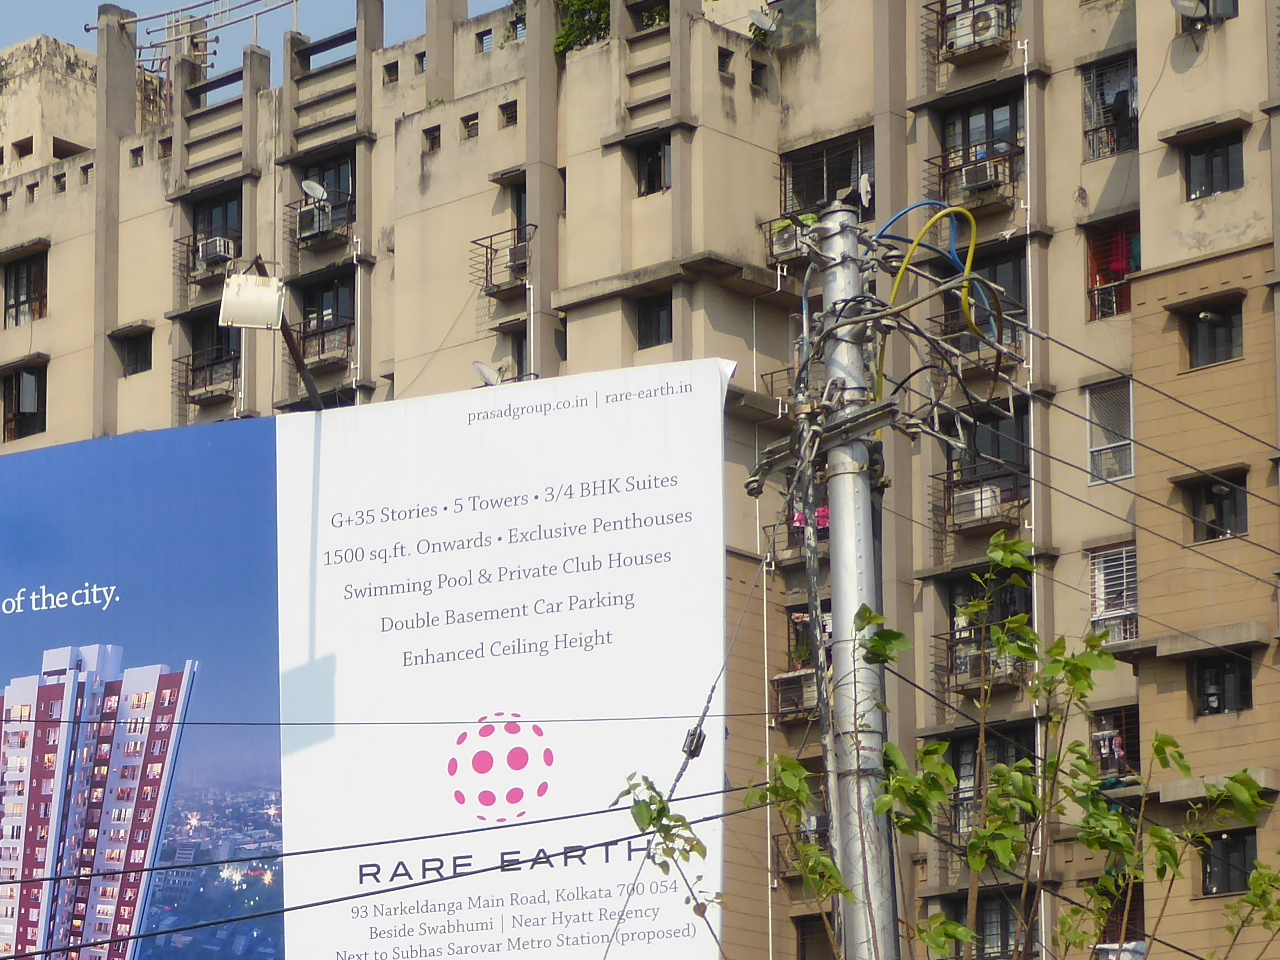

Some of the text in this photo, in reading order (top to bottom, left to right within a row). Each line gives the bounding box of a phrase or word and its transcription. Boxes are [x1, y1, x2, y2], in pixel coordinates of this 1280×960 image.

[467, 381, 693, 425] prasadgroup.co.in rare-earth.in
[331, 473, 678, 529] G+35 Stories 5 Towers 3/4 BHK Suites
[324, 509, 692, 565] 1500 sq.ft. Onwards Exclusive Penthouses
[344, 549, 671, 600] Swimming Pool & Private Club Houses
[2, 590, 26, 614] of
[31, 587, 68, 610] the
[71, 583, 120, 612] city.
[381, 590, 635, 632] Double Basement Car Parking
[403, 630, 613, 667] Enhanced Ceiling Height
[359, 839, 652, 884] RARE EARTH
[351, 880, 678, 919] 93 Narkeldanga Main Road, Kolkata 700 054
[369, 904, 659, 940] Beside Swabhumi Near Hyatt Regency
[373, 947, 388, 960] to
[392, 943, 443, 960] Subhas
[447, 939, 502, 956] Sarovar
[507, 934, 551, 951] Metro
[556, 931, 610, 948] Station
[615, 923, 697, 944] (proposed)
